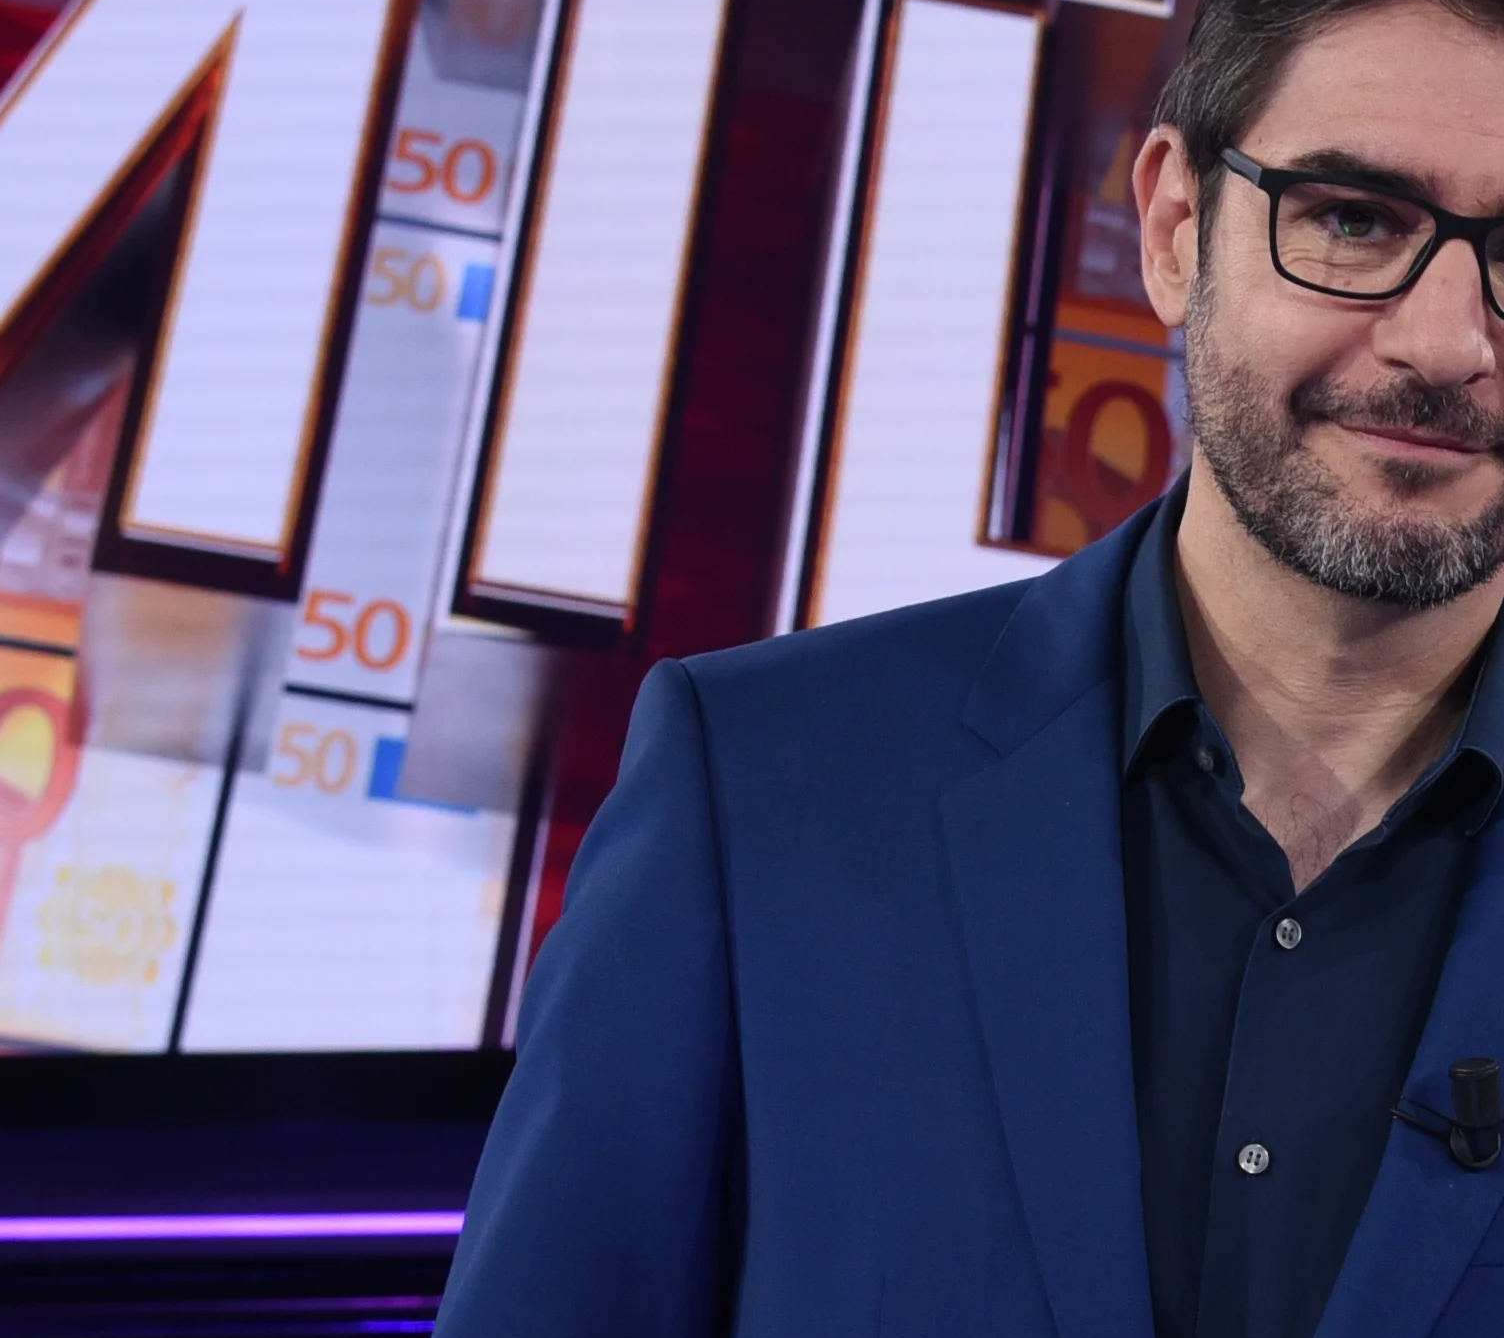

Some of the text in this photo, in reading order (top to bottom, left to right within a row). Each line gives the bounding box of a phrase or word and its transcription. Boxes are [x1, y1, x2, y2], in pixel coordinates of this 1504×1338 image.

[388, 129, 500, 206] 50
[362, 248, 452, 318] 50
[294, 589, 413, 672] 50
[273, 721, 358, 796] 50
